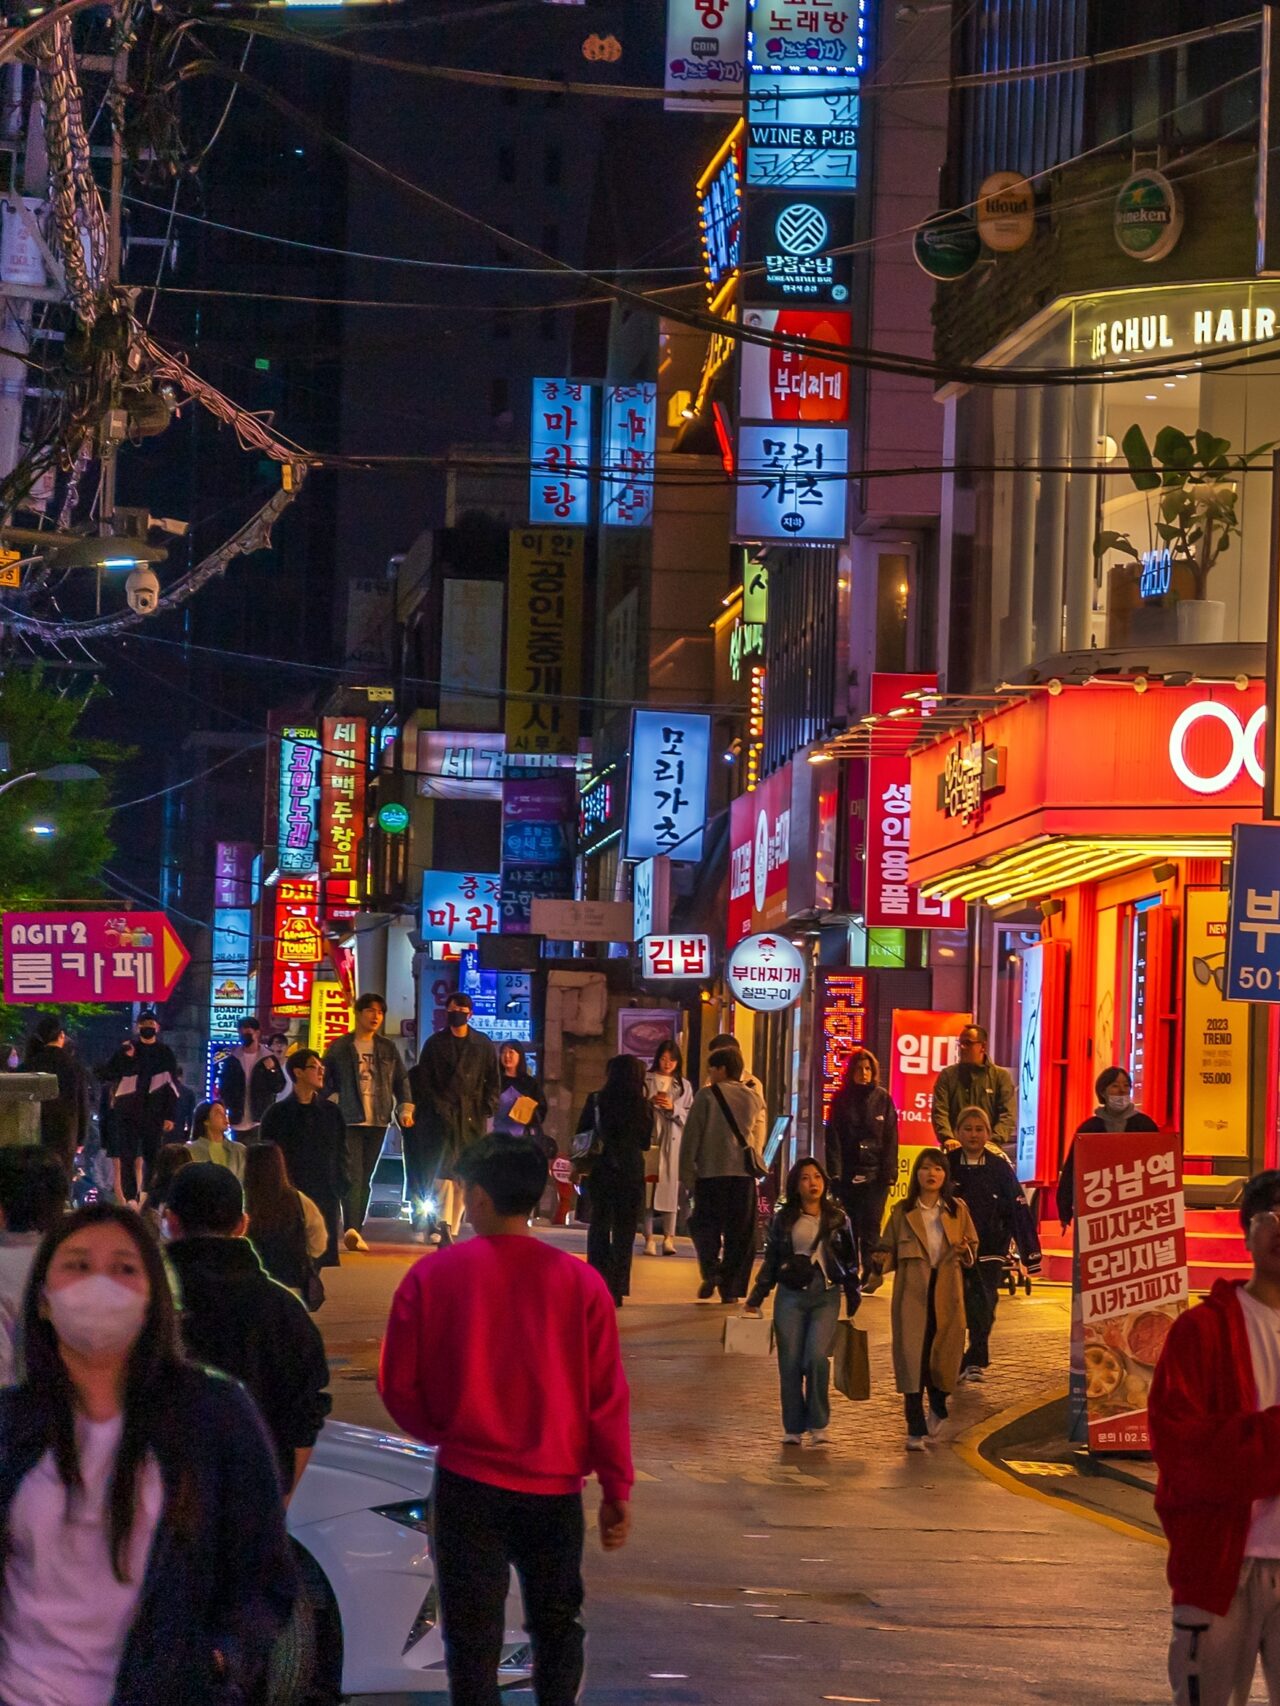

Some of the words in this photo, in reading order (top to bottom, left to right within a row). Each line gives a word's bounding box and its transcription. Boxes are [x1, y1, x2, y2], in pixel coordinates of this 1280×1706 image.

[769, 10, 848, 34] 노래방
[693, 41, 717, 51] COIN
[752, 127, 799, 145] WINE
[803, 128, 818, 145] &
[822, 129, 855, 145] PUB
[541, 383, 582, 401] 중경
[774, 368, 841, 401] 부대찌개
[543, 405, 577, 517] 마라탕
[762, 438, 822, 470] 모리
[762, 474, 823, 506] 가츠
[783, 517, 803, 528] 지하
[523, 560, 566, 732] 공인중개사
[654, 726, 688, 846] 모리가츠
[1209, 924, 1227, 935] NEW
[282, 942, 316, 954] TOUCH
[649, 938, 706, 974] 김밥
[732, 966, 800, 983] 부대찌개
[741, 987, 791, 1001] 철판구이
[214, 1006, 243, 1014] BOARD
[324, 989, 350, 1047] STEA
[1207, 1019, 1228, 1030] 2023
[1203, 1033, 1231, 1045] TREND
[1083, 1151, 1176, 1209] 강남역
[1087, 1199, 1175, 1246] 피자맛집
[1087, 1236, 1177, 1284] 오리지널
[1089, 1272, 1182, 1318] 시카고피자
[1098, 1432, 1116, 1443] 문의
[1124, 1431, 1148, 1443] 02.5
